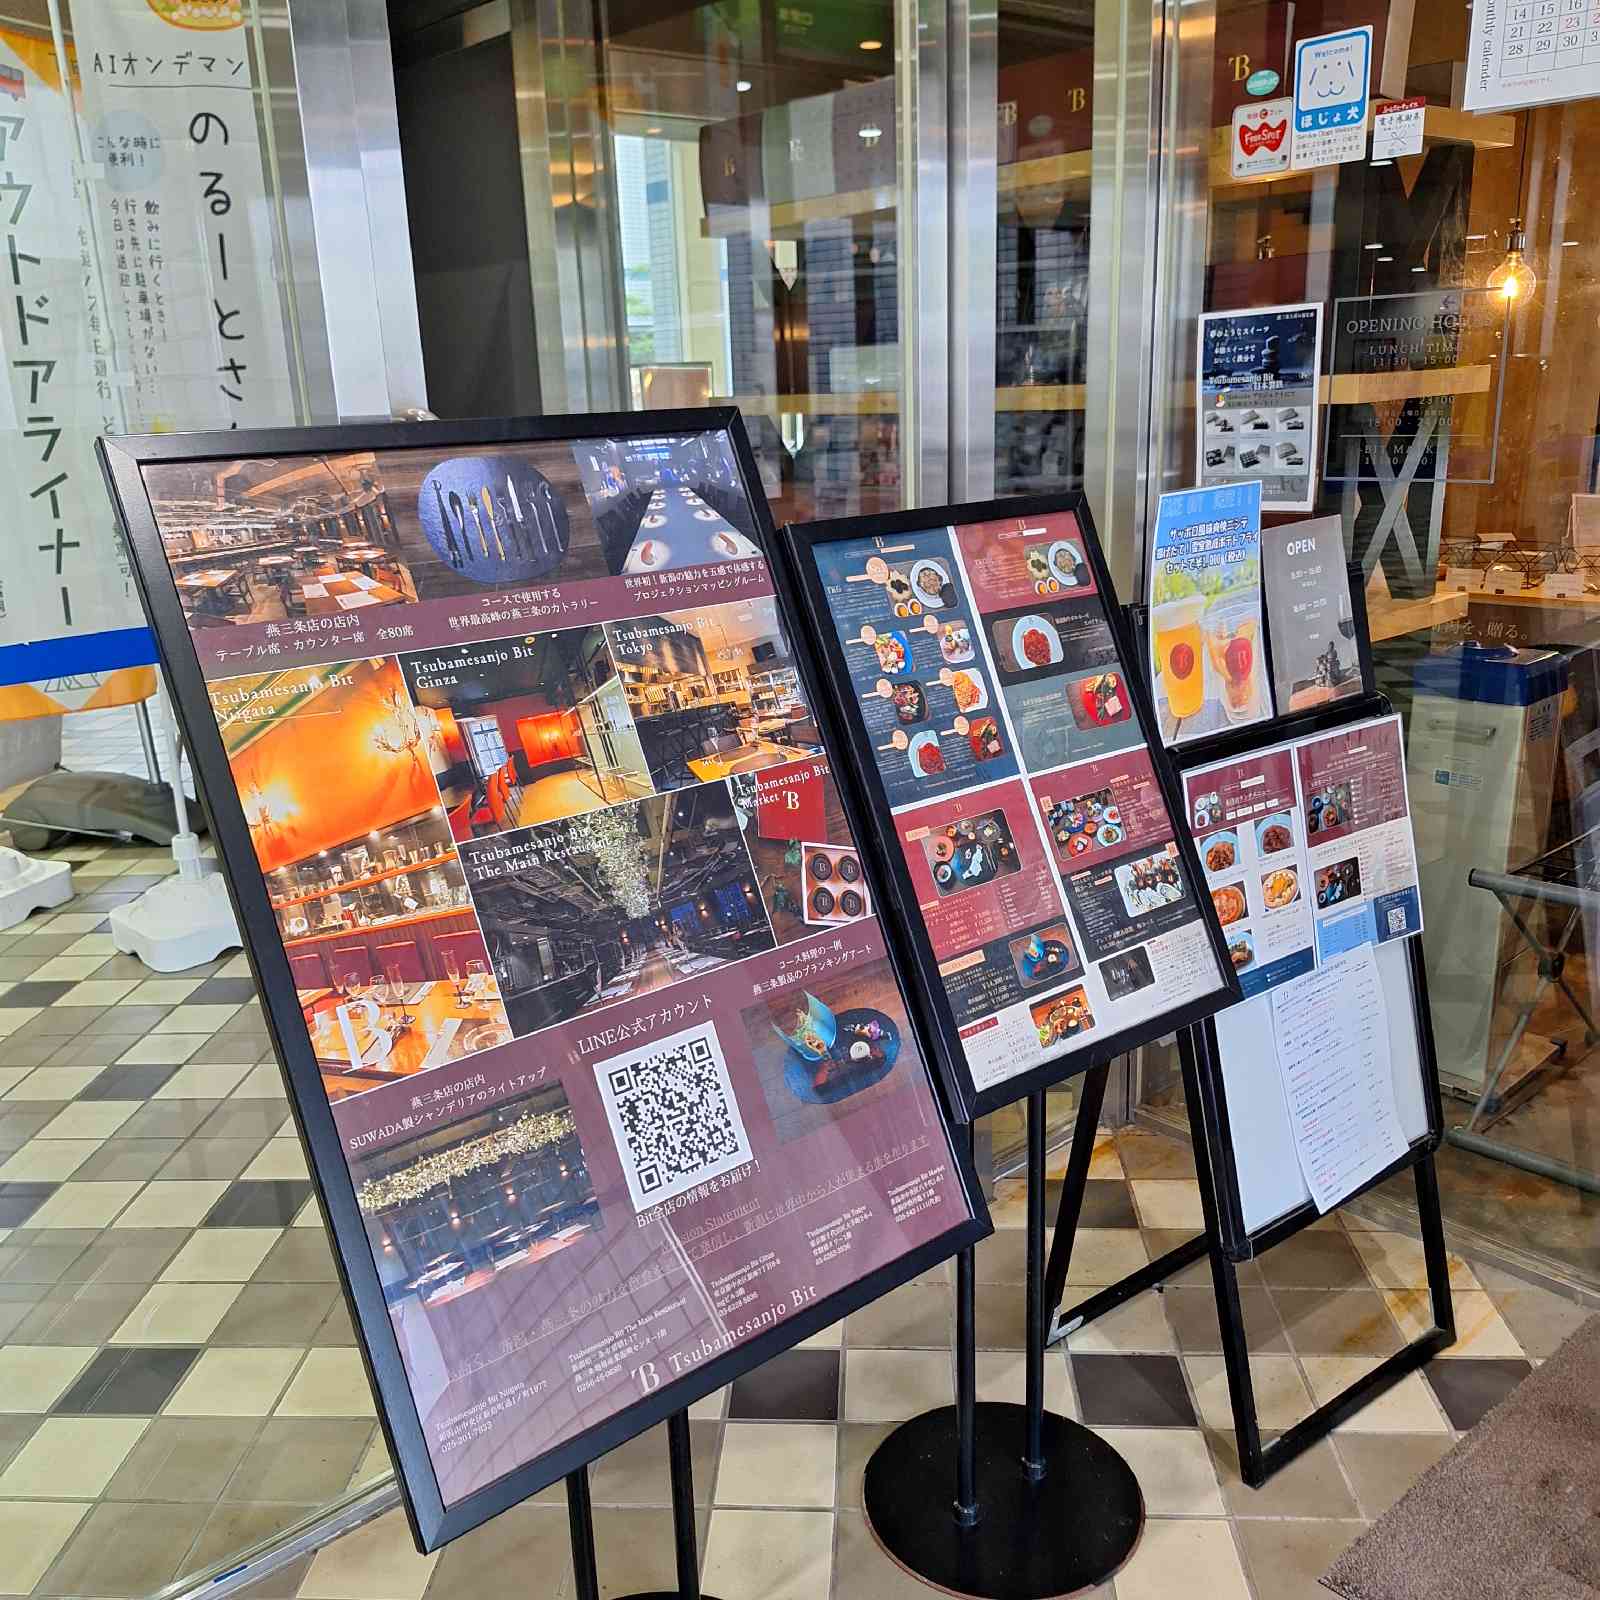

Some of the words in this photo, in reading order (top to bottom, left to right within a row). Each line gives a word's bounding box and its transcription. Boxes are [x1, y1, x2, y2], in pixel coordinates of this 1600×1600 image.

[1514, 8, 1526, 21] 14
[1541, 3, 1555, 15] 15
[1510, 26, 1523, 38] 21
[1537, 21, 1552, 33] 22
[1566, 17, 1580, 29] 23
[1508, 43, 1524, 55] 28
[1536, 40, 1551, 51] 29
[1563, 35, 1578, 47] 30
[1301, 105, 1360, 129] ほじょ犬
[188, 112, 246, 430] のるーとさ
[1369, 344, 1419, 355] LUNCH
[1286, 537, 1317, 557] OPEN
[481, 588, 561, 607] コースで使用する
[266, 614, 360, 639] 燕三条店の店内
[376, 624, 415, 641] 全80席
[612, 622, 693, 643] Tsubamesanjo
[410, 649, 508, 675] Tsubamesanjo
[511, 645, 535, 660] Bit
[616, 642, 653, 658] Tokyo
[208, 679, 324, 706] Tsubamesanjo
[328, 672, 354, 689] Bit
[416, 674, 458, 690] Ginza
[213, 705, 276, 724] Niigata
[736, 770, 810, 797] Tsubamesanjo
[812, 764, 831, 777] Bit
[741, 792, 780, 810] Market
[468, 833, 565, 866] Tsubamesanjo
[472, 864, 502, 881] The
[503, 854, 541, 874] Main
[542, 837, 610, 863] Restaurant
[577, 993, 713, 1056] LINE公式アカウント
[410, 1073, 487, 1111] 燕三条店の店内
[669, 1302, 787, 1373] Tsubamesanjo
[791, 1284, 819, 1309] Bit
